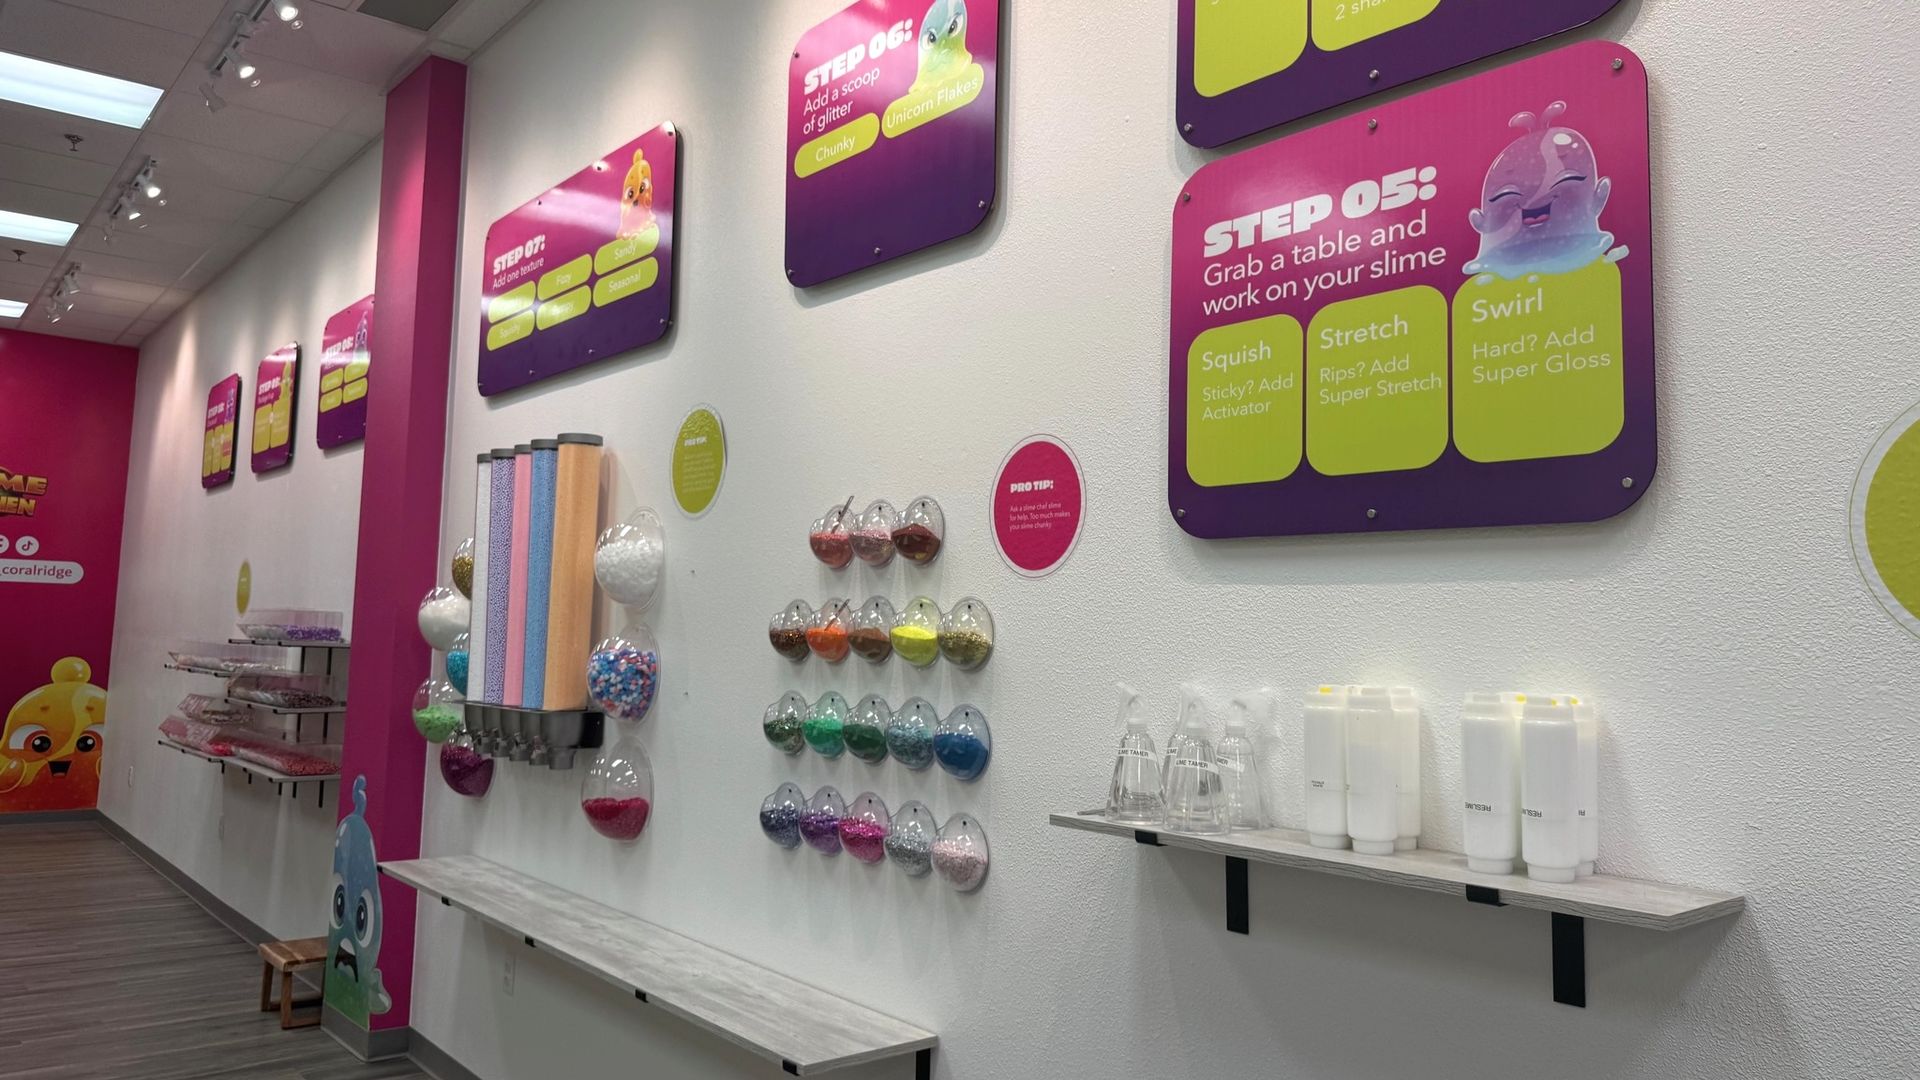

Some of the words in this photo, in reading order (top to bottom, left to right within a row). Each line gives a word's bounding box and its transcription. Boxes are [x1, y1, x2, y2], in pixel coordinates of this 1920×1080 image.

[1335, 5, 1345, 20] 2
[804, 43, 865, 95] STEP
[868, 18, 913, 59] 06:
[803, 88, 829, 116] Add
[831, 89, 839, 100] a
[841, 67, 881, 97] scoop
[887, 99, 934, 129] Unicorn
[937, 76, 978, 106] Flakes
[803, 117, 816, 135] of
[817, 100, 854, 132] glitter
[815, 135, 856, 163] Chunky
[1203, 193, 1333, 258] STEP
[1341, 166, 1437, 219] 05:
[493, 245, 524, 276] STEP
[524, 234, 546, 259] 07:
[1203, 254, 1264, 287] Grab
[1270, 254, 1285, 271] a
[1291, 230, 1362, 265] table
[1370, 208, 1427, 247] and
[492, 278, 506, 291] Add
[506, 270, 520, 283] one
[520, 257, 545, 276] texture
[608, 269, 641, 293] Seasonal
[1202, 282, 1260, 316] work
[1265, 279, 1297, 301] on
[1303, 263, 1365, 301] your
[1370, 247, 1447, 279] slime
[1472, 287, 1543, 323] Swirl
[1319, 314, 1409, 350] Stretch
[1472, 334, 1538, 360] Hard?
[1544, 324, 1594, 349] Add
[1201, 340, 1272, 373] Squish
[1319, 361, 1366, 385] Rips?
[1369, 353, 1410, 376] Add
[1472, 362, 1539, 385] Super
[1545, 352, 1611, 373] Gloss
[1202, 380, 1255, 402] Sticky?
[1258, 373, 1294, 394] Add
[1319, 385, 1371, 406] Super
[1376, 372, 1442, 397] Stretch
[1202, 400, 1272, 421] Activator
[0, 472, 48, 495] ME
[1010, 481, 1033, 494] PRO
[1033, 479, 1054, 491] TIP:
[1130, 749, 1149, 757] TAMER
[1188, 760, 1208, 768] TAMER
